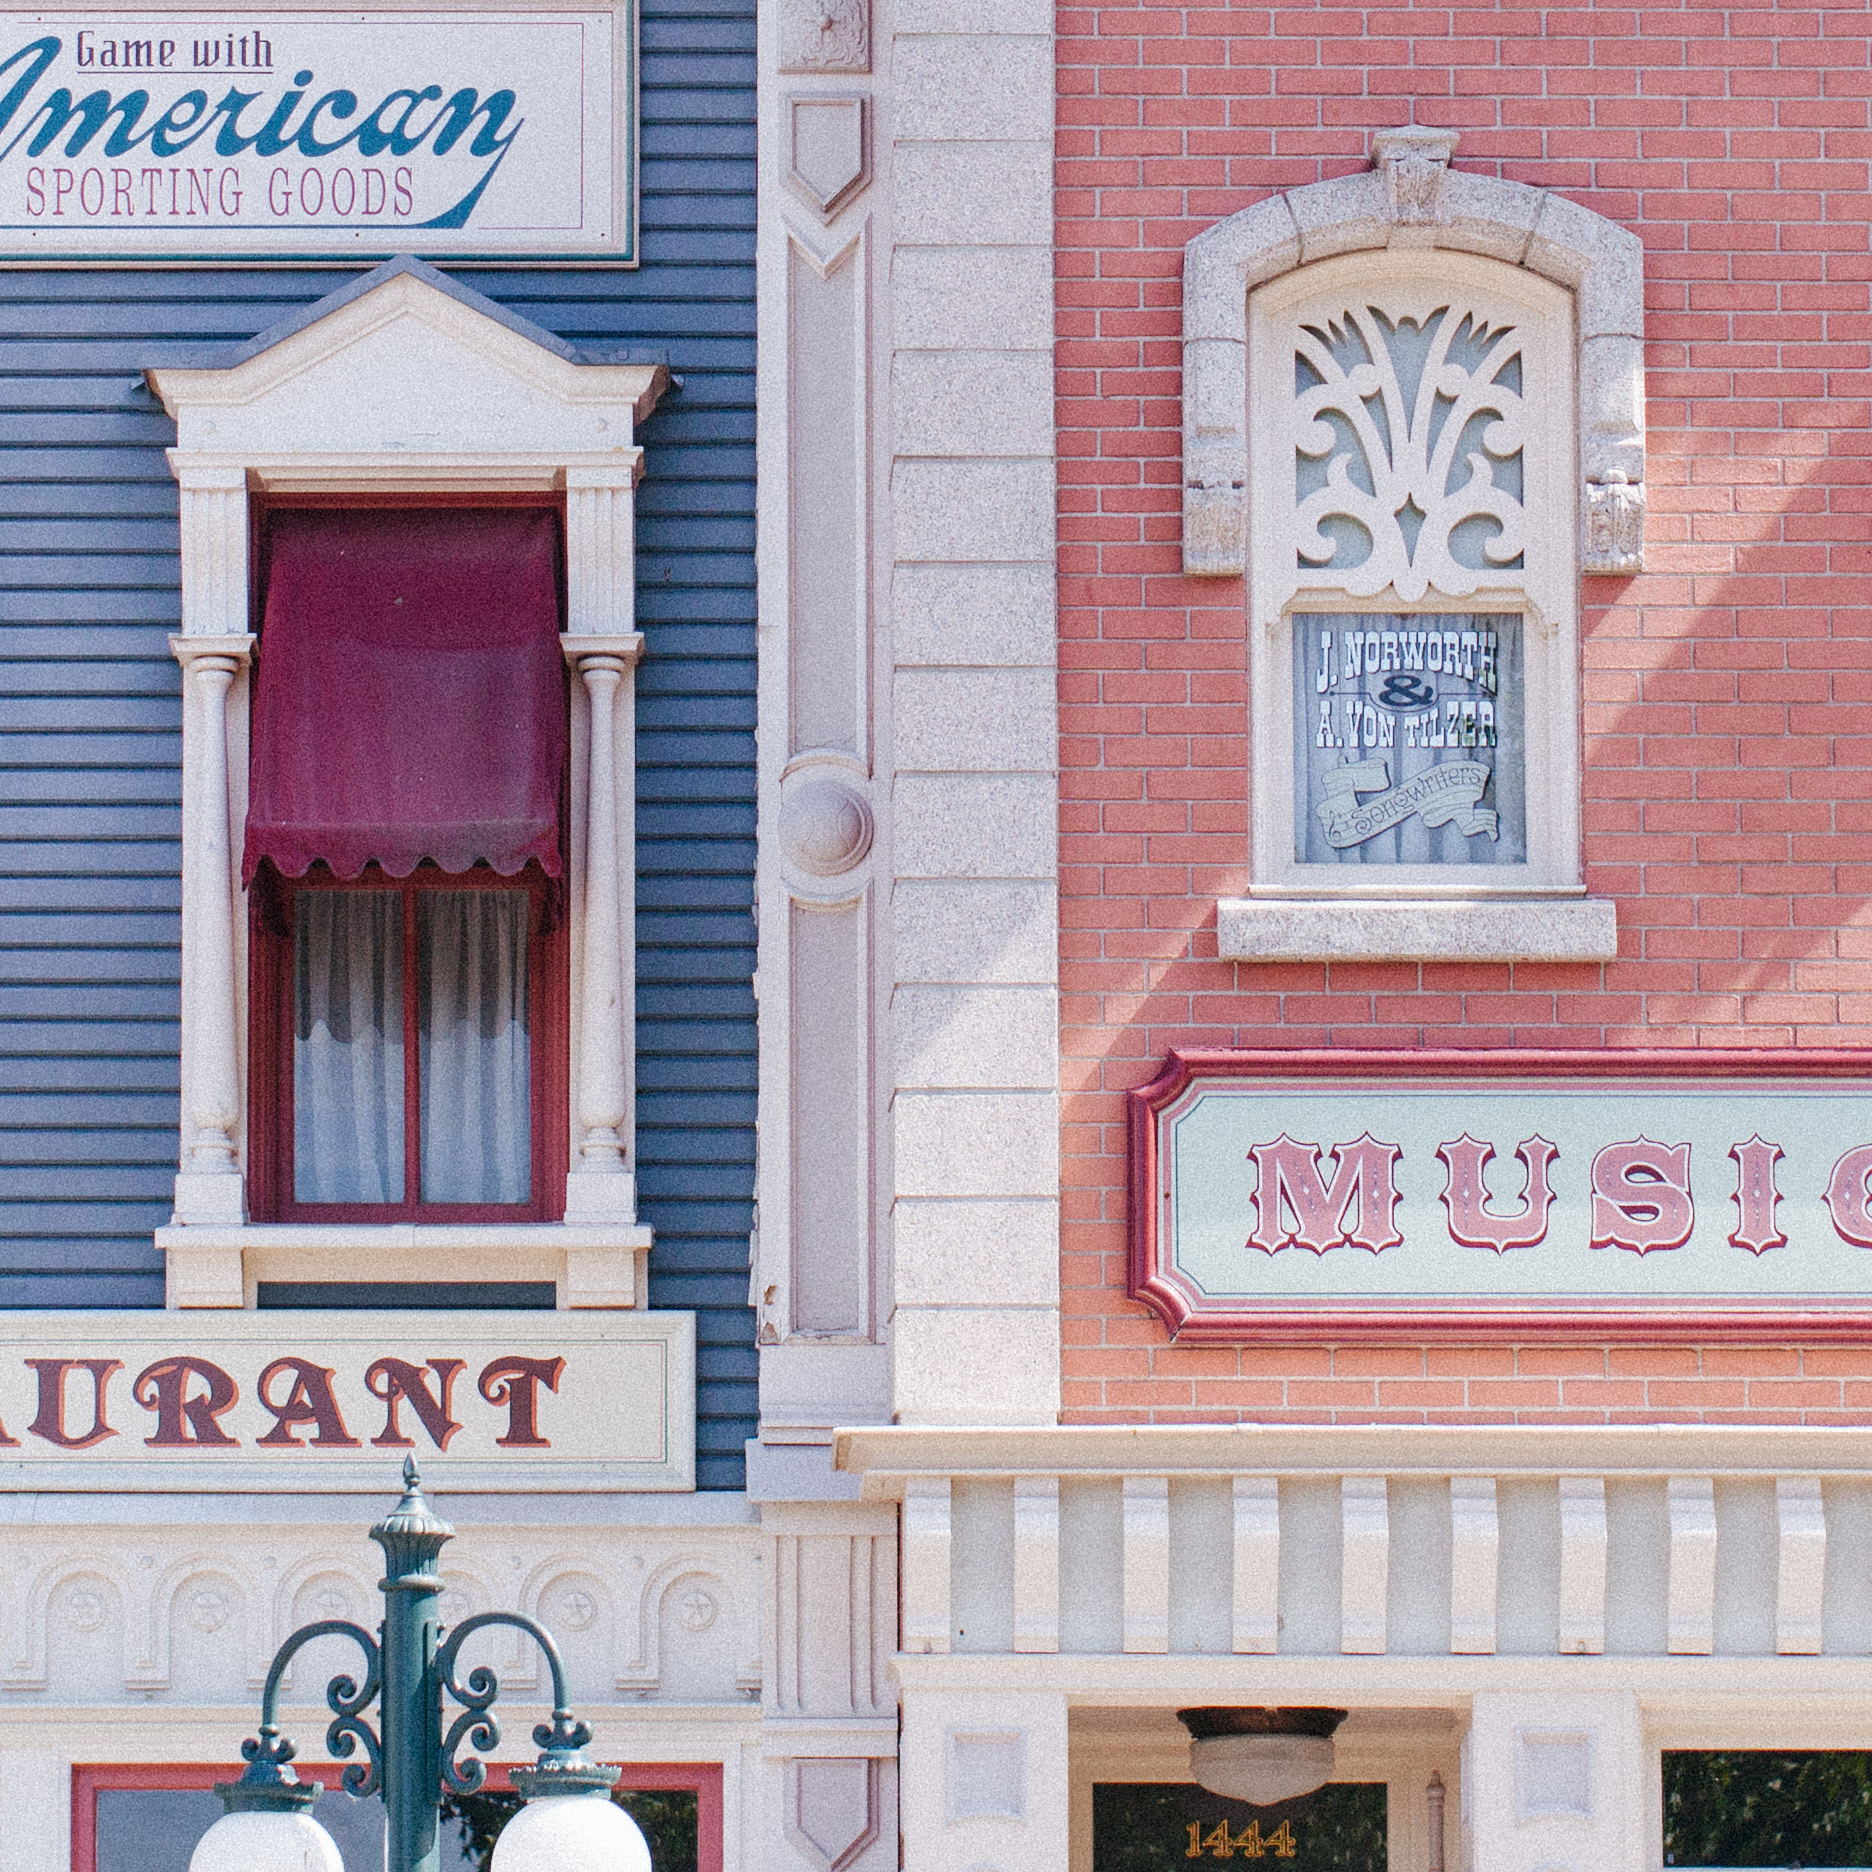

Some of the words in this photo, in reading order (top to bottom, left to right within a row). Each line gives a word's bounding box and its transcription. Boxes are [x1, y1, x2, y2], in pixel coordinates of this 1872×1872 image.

[77, 30, 174, 68] Game
[193, 30, 274, 68] with
[27, 167, 244, 217] SPORTING
[269, 167, 415, 217] GOODS
[1316, 631, 1338, 694] J.
[1344, 631, 1498, 695] NORWORTH
[1378, 674, 1434, 707] &
[1346, 700, 1396, 748] VON
[1405, 700, 1498, 748] TILZER
[1354, 765, 1481, 835] Songwriters
[1185, 1819, 1296, 1858] 1444
